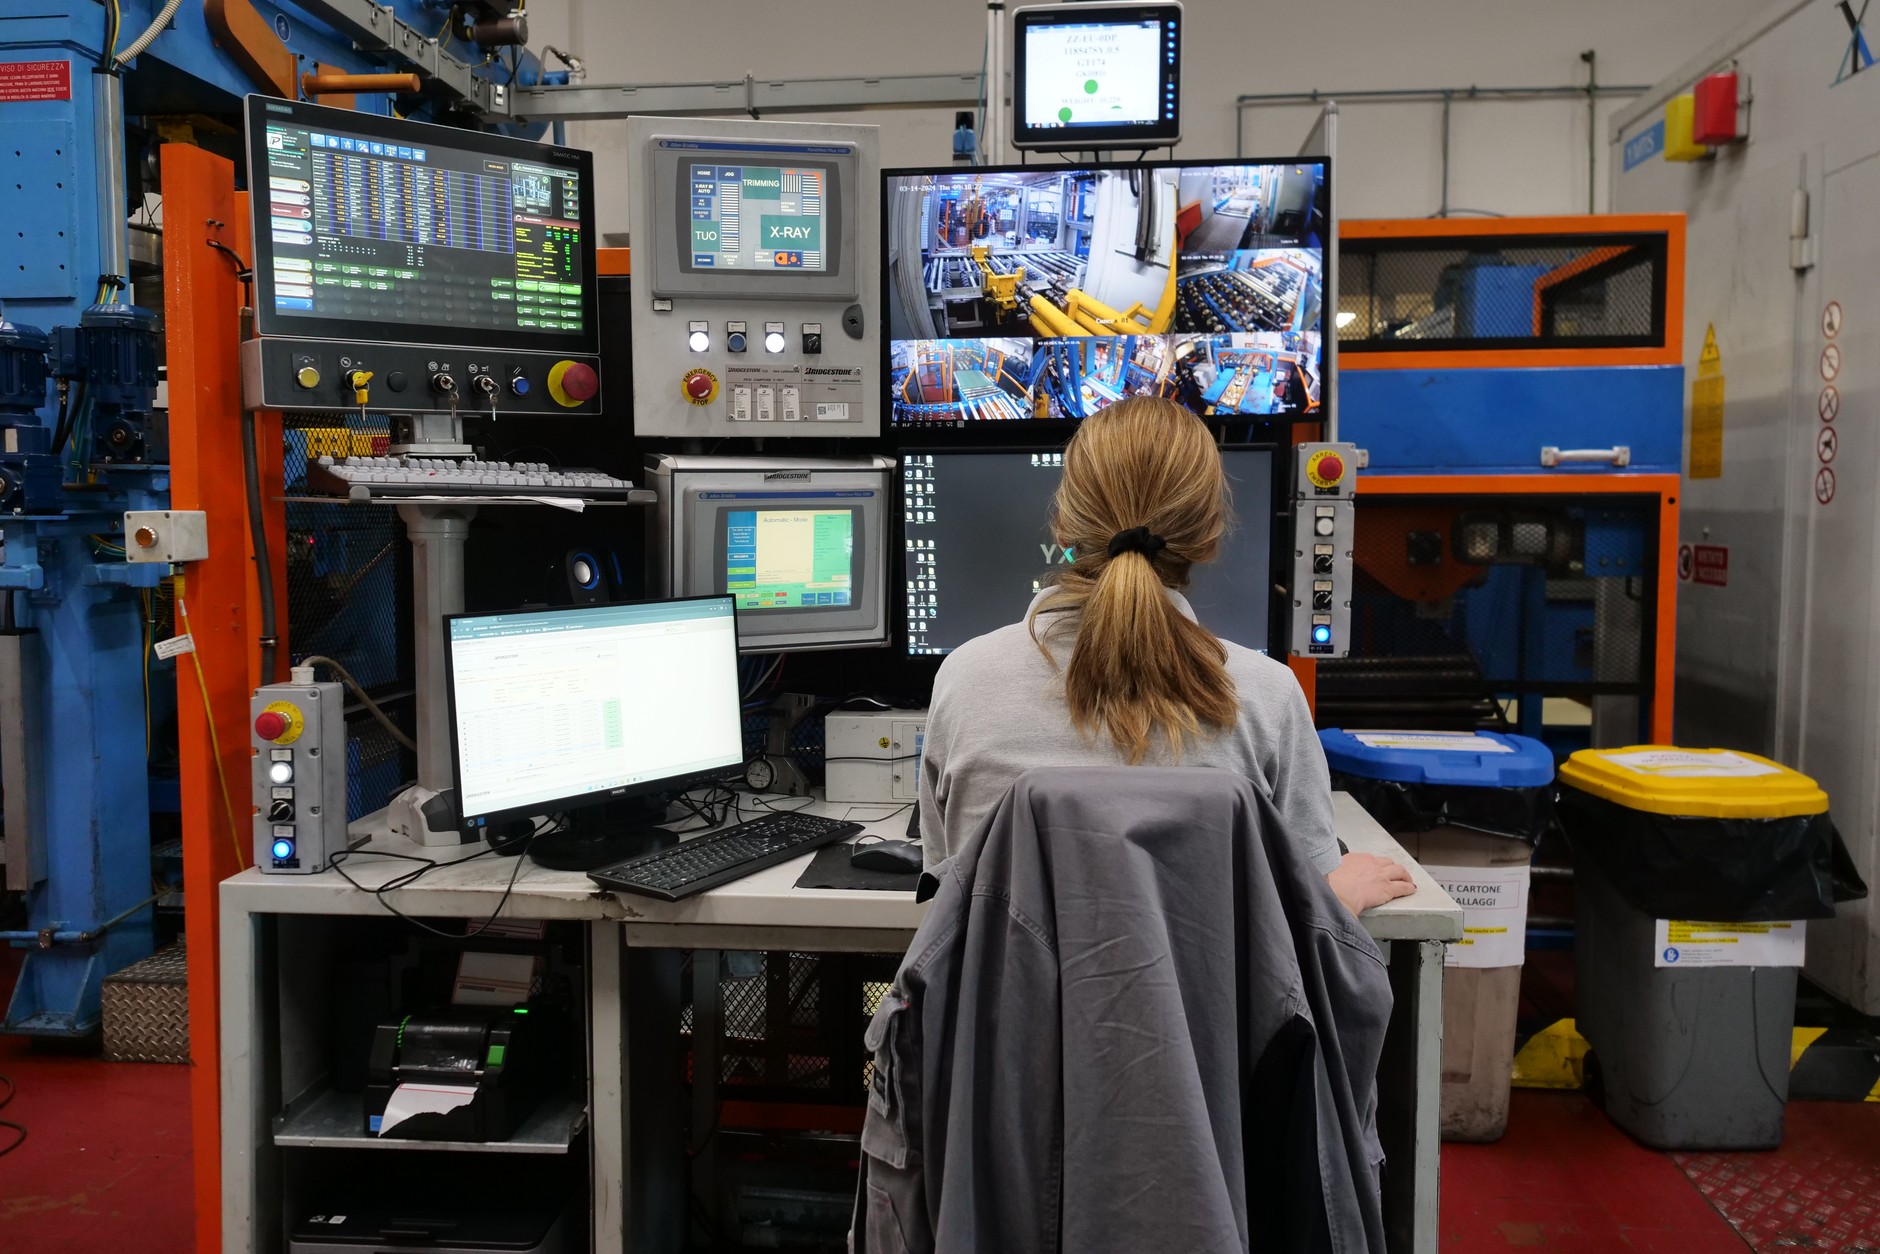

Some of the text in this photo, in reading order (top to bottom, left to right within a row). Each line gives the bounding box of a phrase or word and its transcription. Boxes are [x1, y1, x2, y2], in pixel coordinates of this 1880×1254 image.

[26, 63, 65, 71] SICUREZZA
[267, 104, 291, 113] SIEMENS
[743, 179, 780, 188] TRIMMING
[695, 231, 717, 241] TUO
[770, 226, 811, 239] X-RAY
[683, 368, 718, 383] EMERGENCY
[805, 367, 852, 375] BRIDGESTONE
[1448, 884, 1454, 892] E
[1456, 884, 1501, 893] CARTONE
